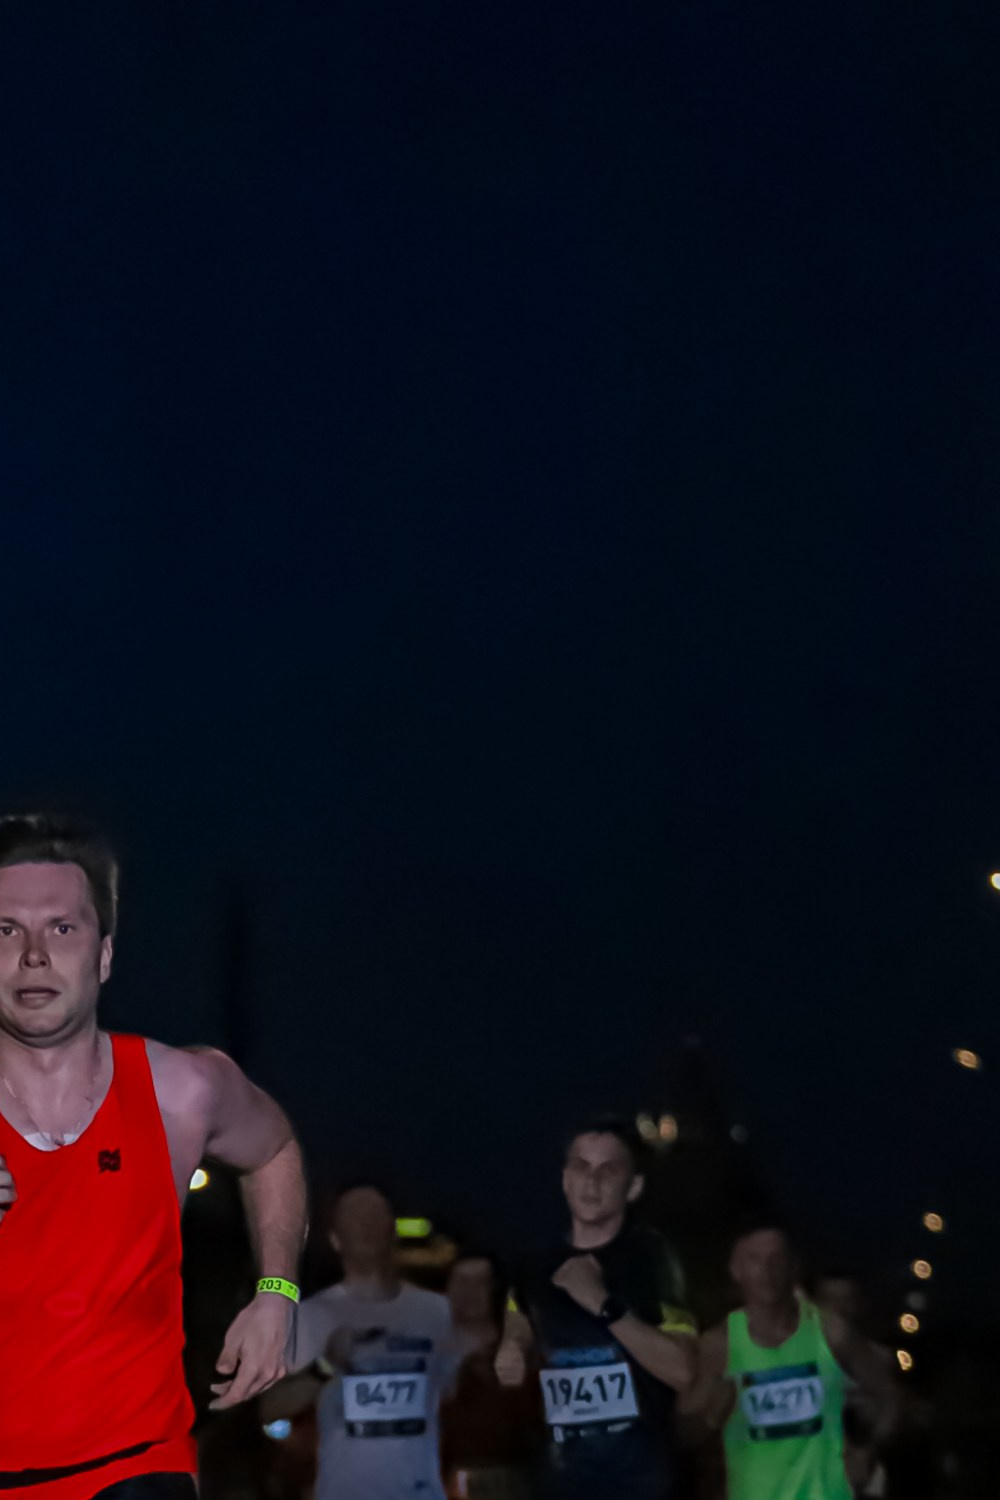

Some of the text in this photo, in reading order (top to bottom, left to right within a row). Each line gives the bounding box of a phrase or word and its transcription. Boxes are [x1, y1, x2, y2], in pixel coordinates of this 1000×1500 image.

[257, 1279, 282, 1290] 203
[355, 1381, 418, 1407] 8477
[547, 1372, 626, 1406] 19417
